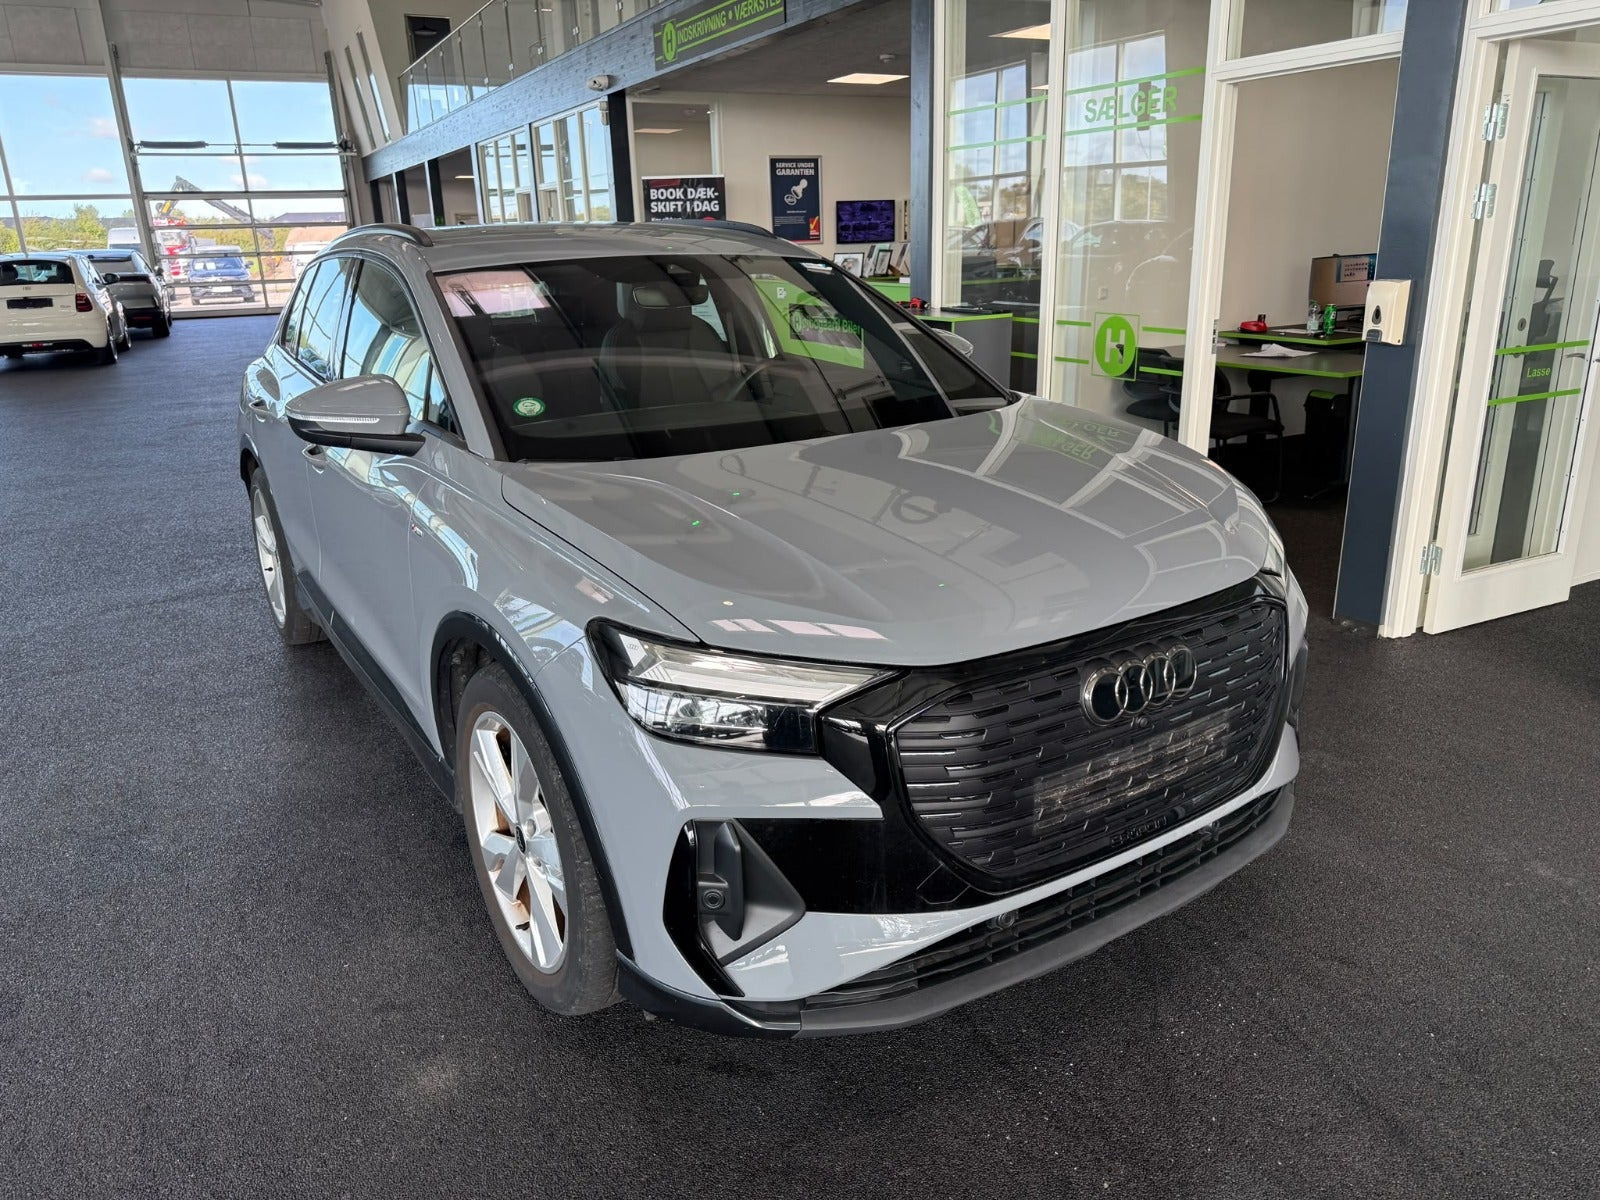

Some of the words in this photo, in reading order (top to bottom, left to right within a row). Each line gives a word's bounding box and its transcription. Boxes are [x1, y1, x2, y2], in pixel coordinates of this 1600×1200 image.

[677, 10, 727, 45] INDSKRIVNING
[1084, 85, 1178, 123] SÆLGER
[775, 168, 815, 176] GARANTIEN
[650, 188, 684, 200] BOOK
[687, 187, 719, 199] DÆK-
[650, 201, 683, 213] SKIFT
[686, 201, 691, 212] I
[693, 200, 720, 212] DAG
[1526, 367, 1551, 378] Lasse
